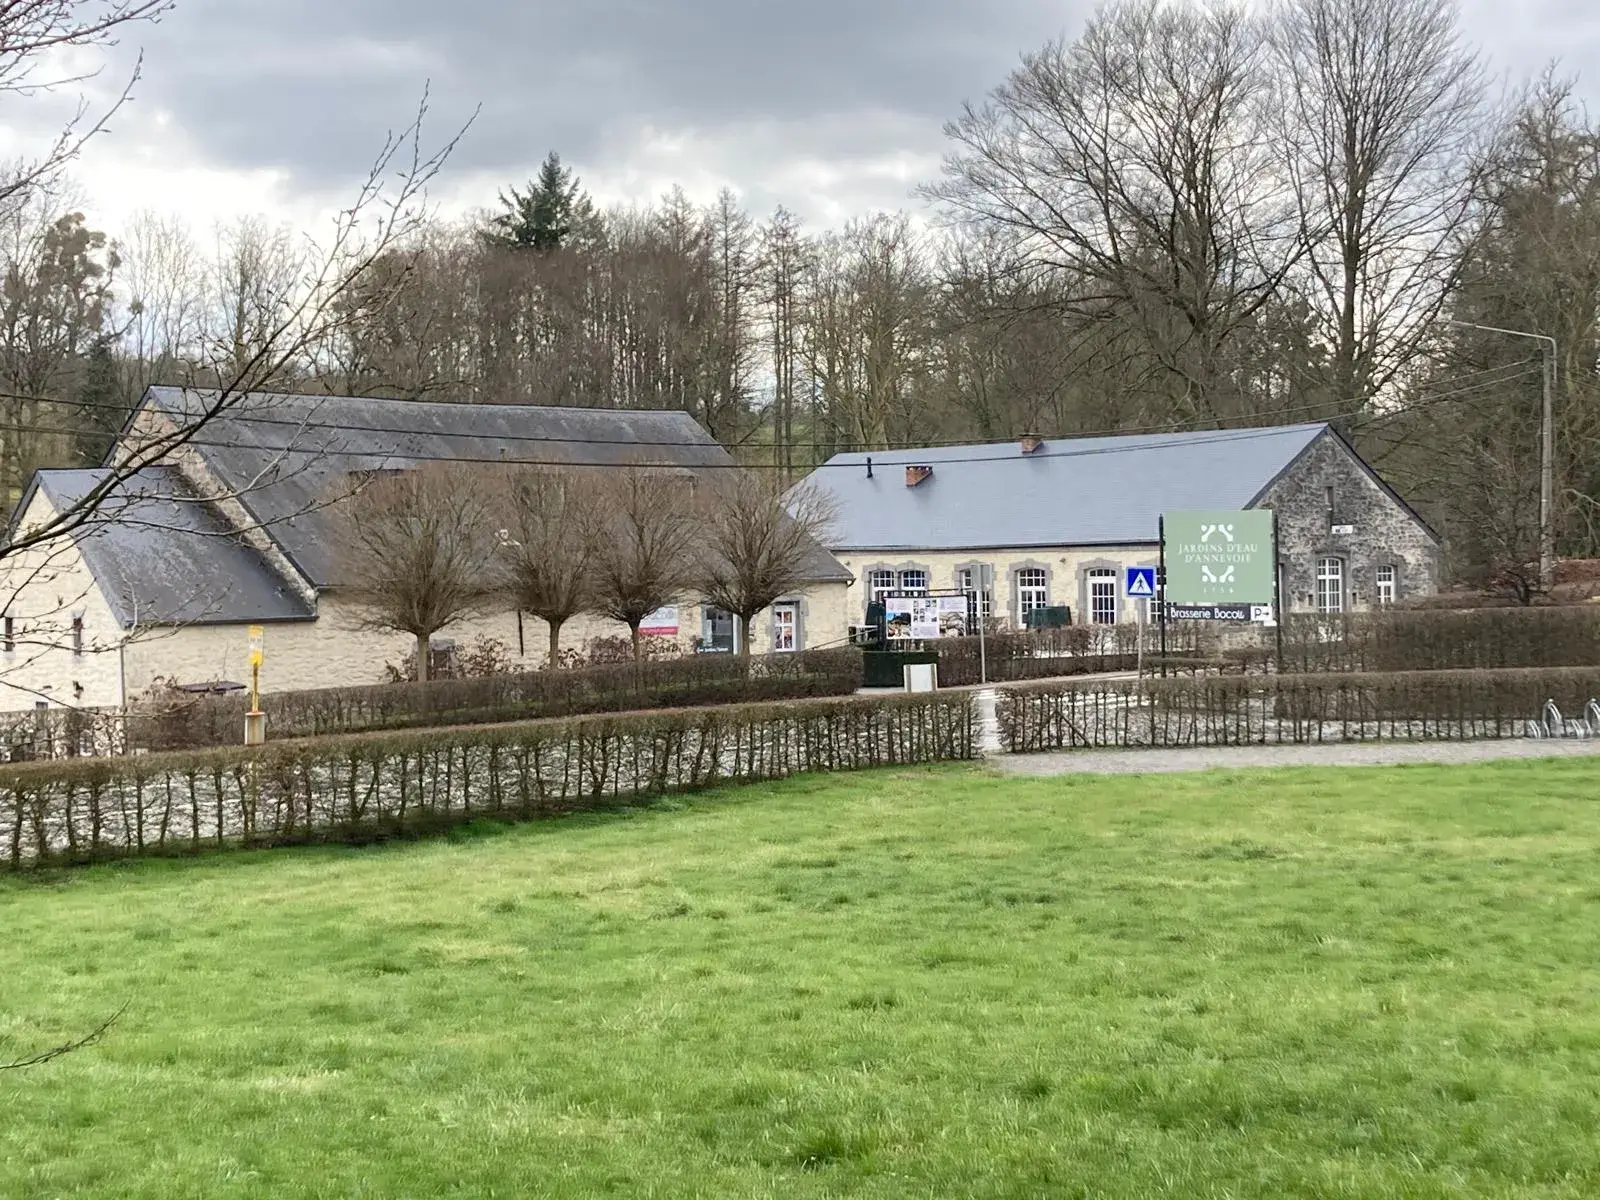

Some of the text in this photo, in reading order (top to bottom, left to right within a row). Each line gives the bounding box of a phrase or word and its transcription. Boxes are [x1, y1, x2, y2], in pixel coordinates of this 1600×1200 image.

[1178, 543, 1258, 555] JARDINS D'EAU
[1184, 553, 1252, 563] D'ANNEVOIE
[1170, 606, 1212, 619] Brasserie
